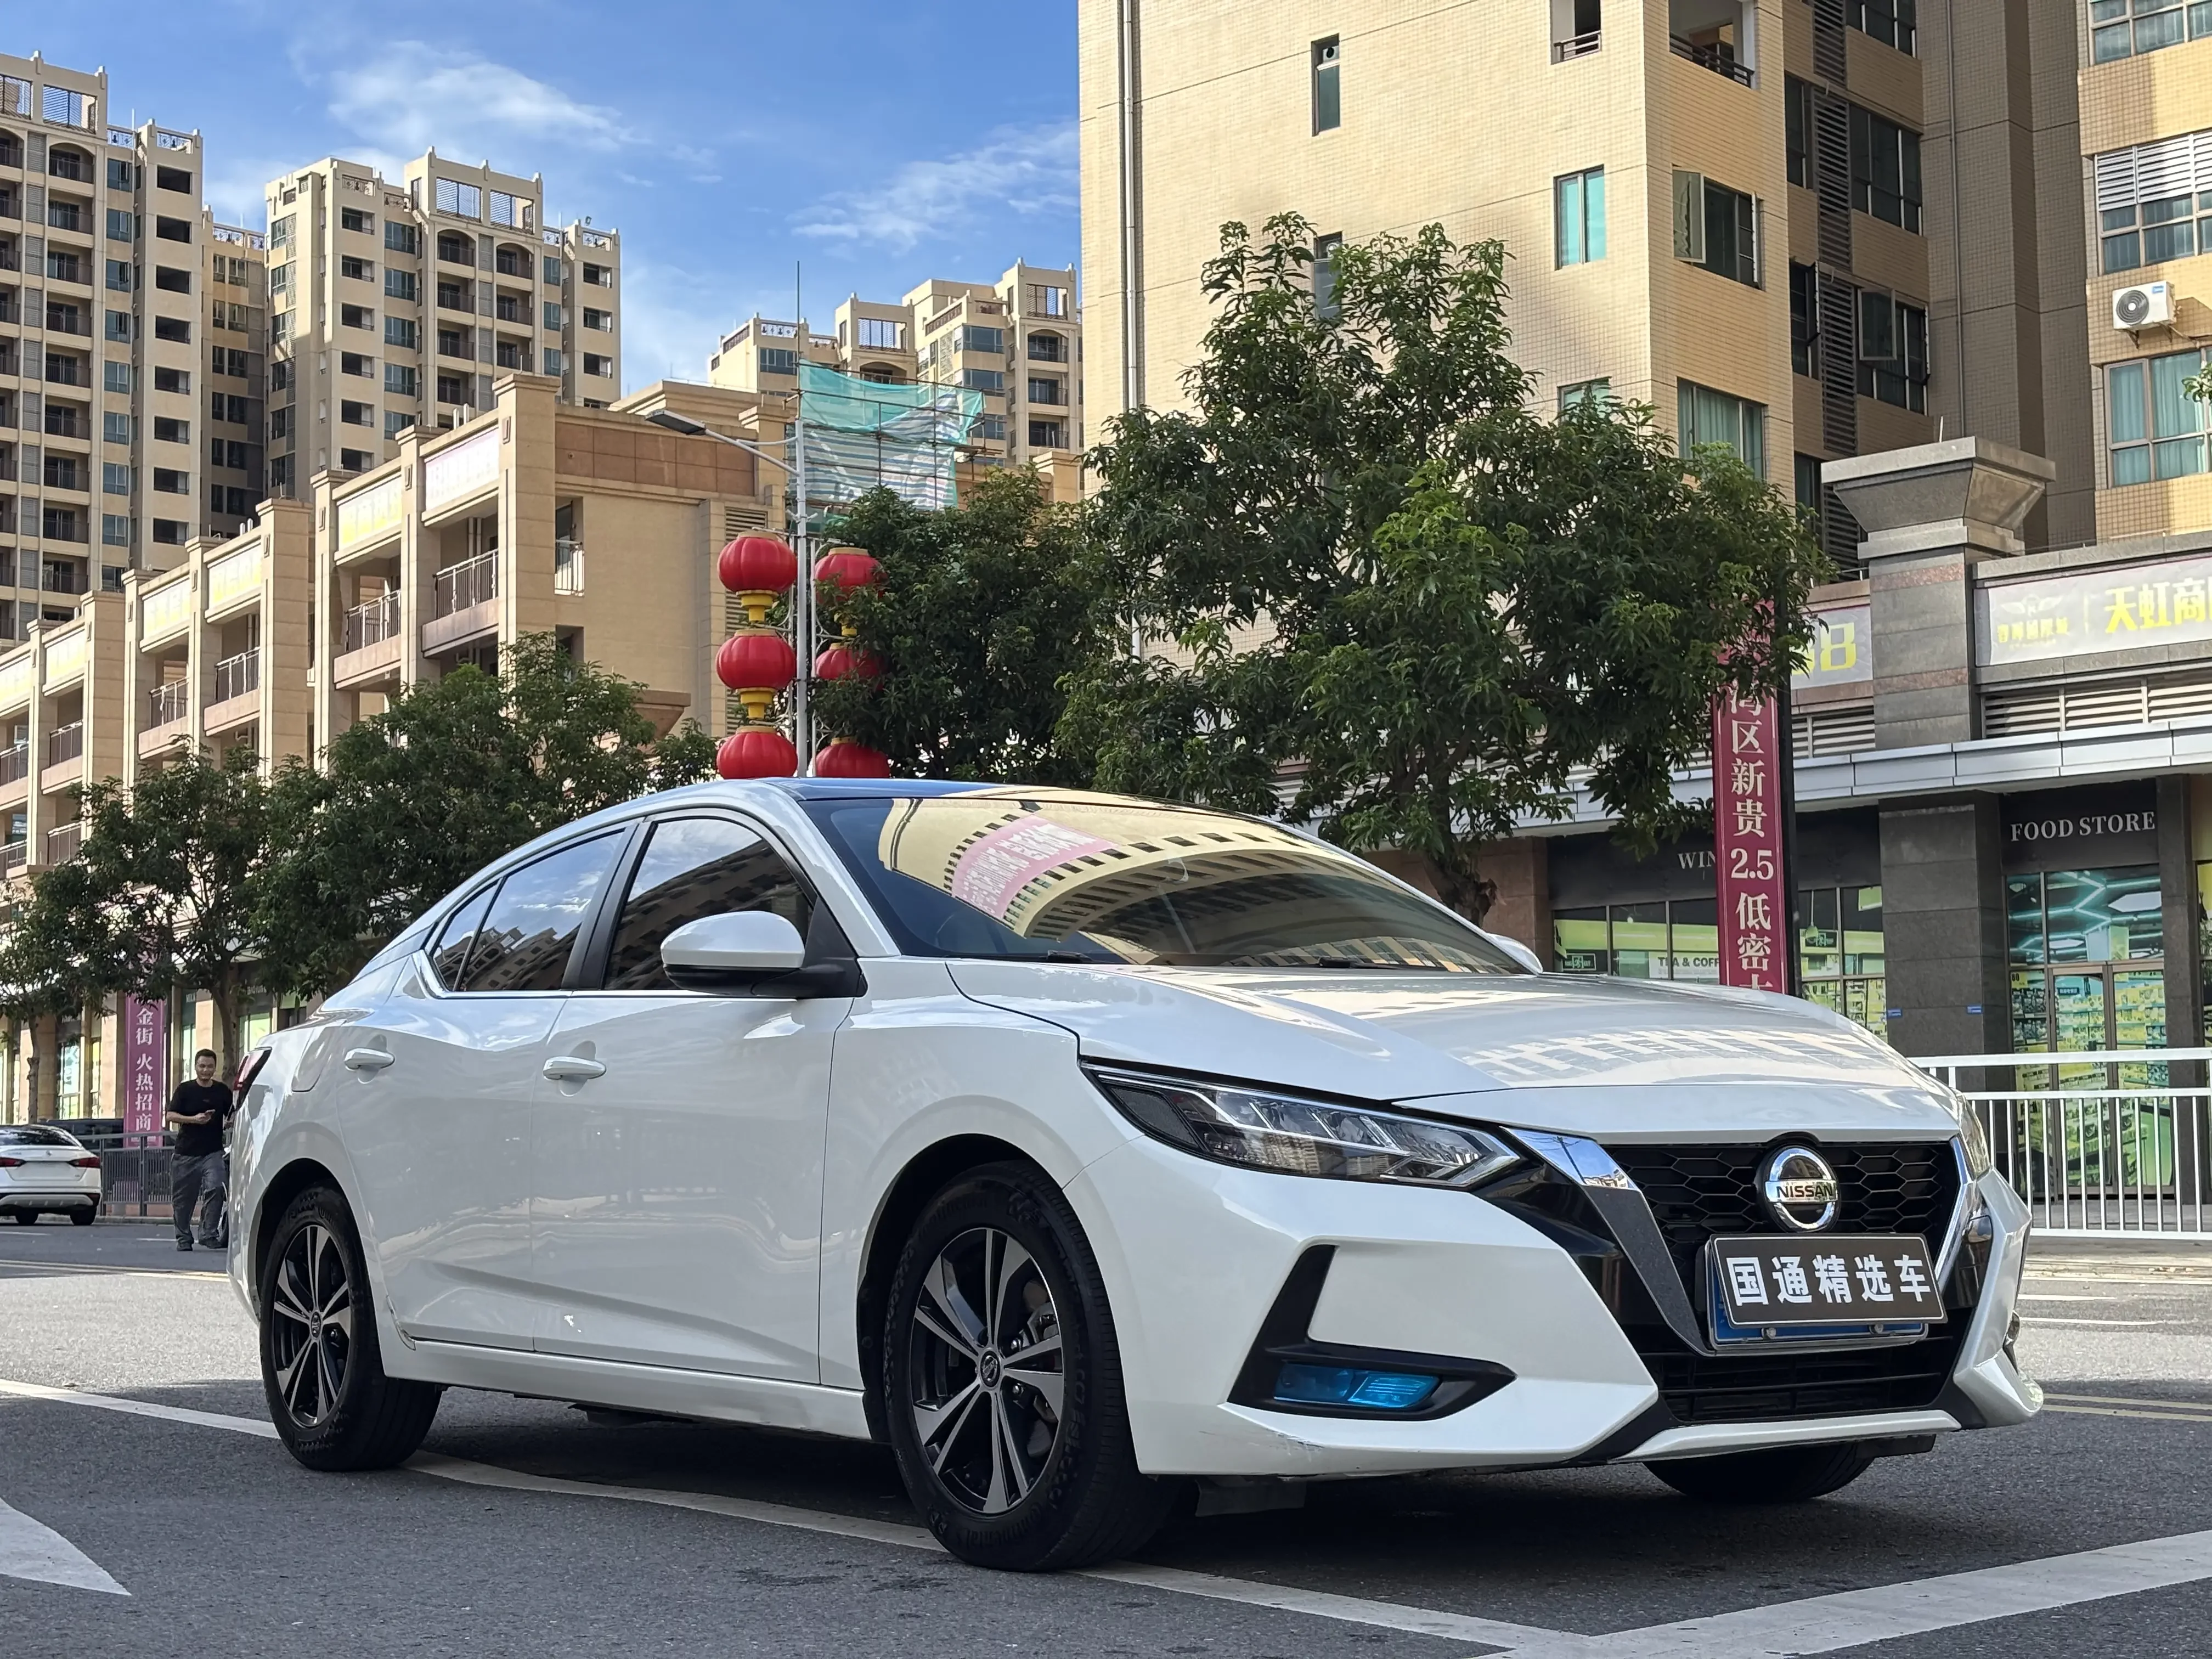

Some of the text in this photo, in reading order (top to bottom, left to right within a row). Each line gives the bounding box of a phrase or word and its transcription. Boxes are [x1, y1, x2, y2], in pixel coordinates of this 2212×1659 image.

[2105, 578, 2211, 633] 天虹商
[2010, 811, 2156, 842] FOOD STORE
[1677, 850, 1716, 870] WIN
[1730, 848, 1774, 881] 2.5
[135, 1053, 154, 1131] 火热招商
[1776, 1184, 1834, 1198] NISSAN
[1725, 1254, 1932, 1307] 国通精选车
